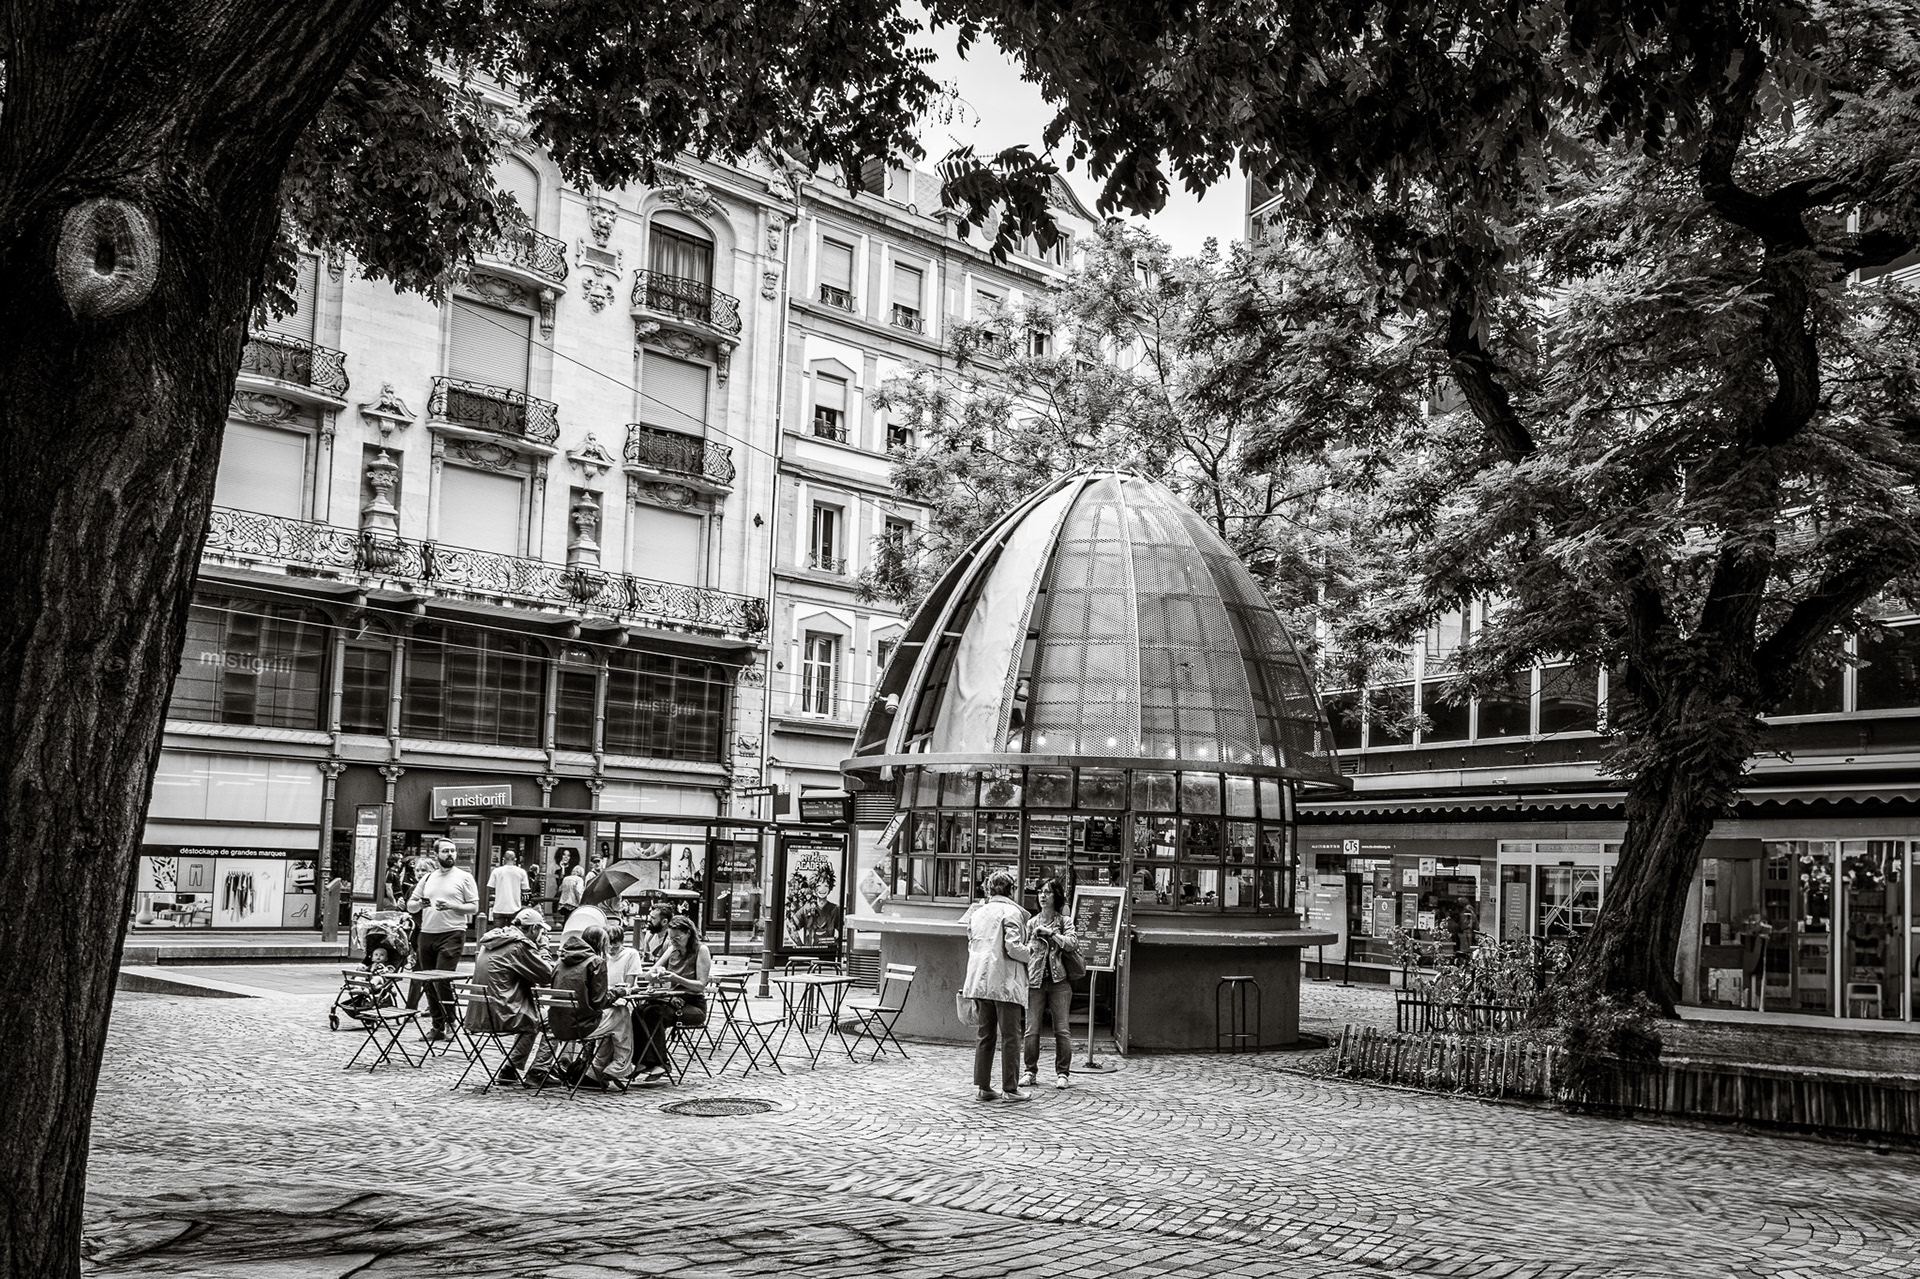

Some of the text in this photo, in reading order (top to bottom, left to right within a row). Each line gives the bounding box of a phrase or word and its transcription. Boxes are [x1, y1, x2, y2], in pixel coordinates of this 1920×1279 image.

[200, 649, 292, 675] mistigriff
[634, 698, 697, 718] mistigriff
[452, 792, 507, 807] mistigriff
[179, 847, 219, 856] déstockage
[230, 848, 257, 857] grandes
[258, 850, 287, 858] marques
[1345, 840, 1358, 853] CTS
[795, 860, 834, 872] ACADEMA
